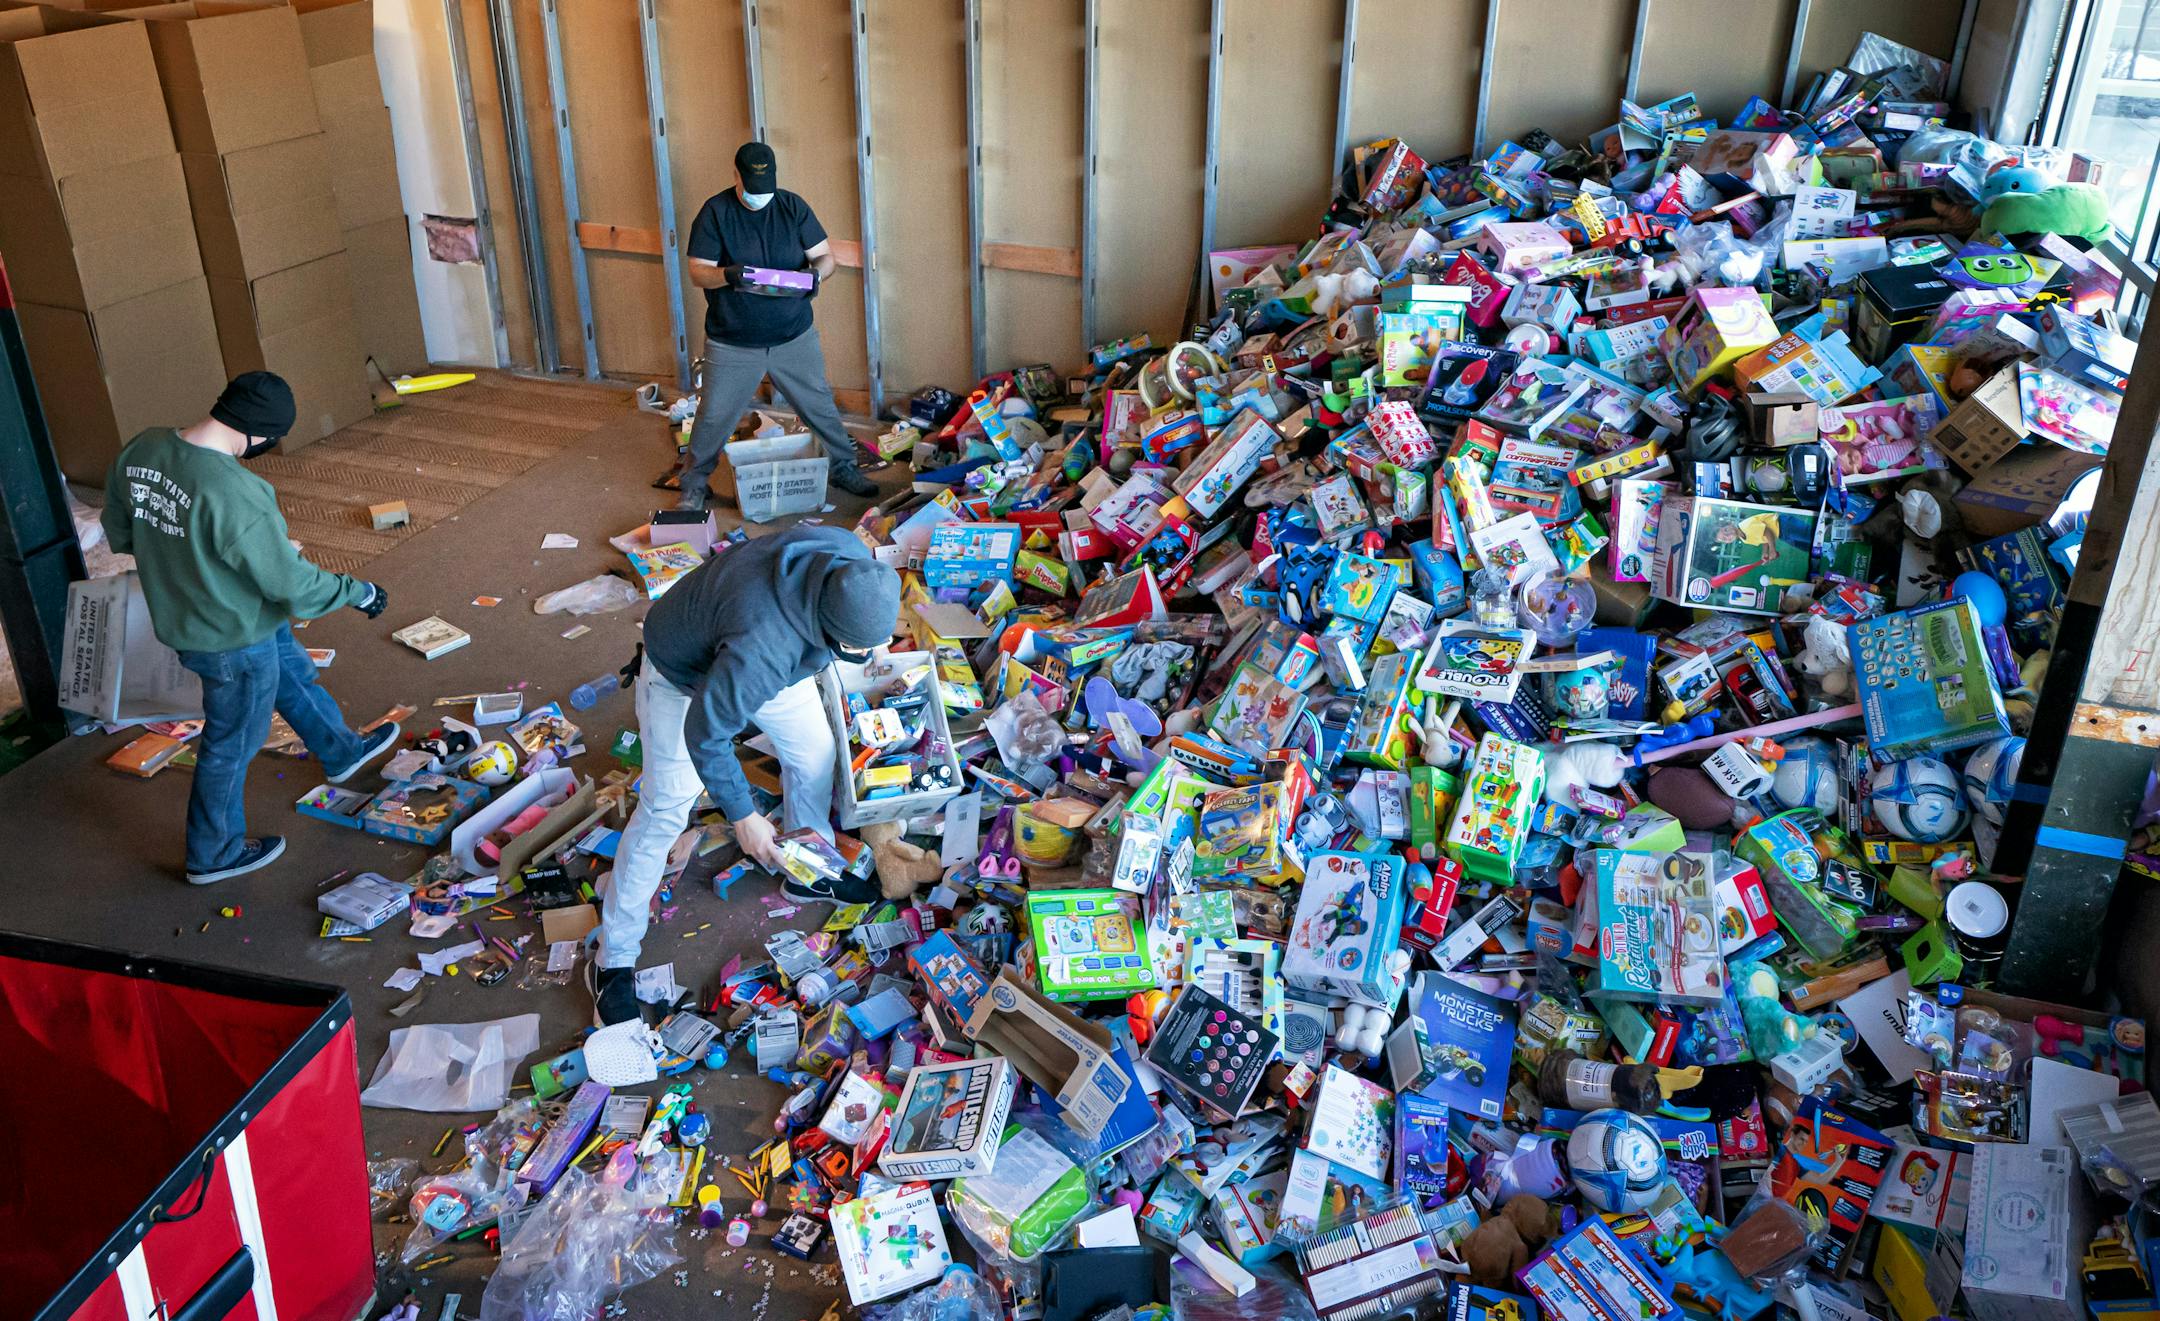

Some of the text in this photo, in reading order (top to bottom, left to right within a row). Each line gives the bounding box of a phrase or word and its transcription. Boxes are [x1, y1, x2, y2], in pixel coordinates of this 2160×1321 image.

[1450, 341, 1496, 358] Discovery
[126, 465, 162, 483] UNITED
[783, 480, 816, 489] STATES
[782, 487, 816, 497] SERVICE
[160, 521, 186, 538] CORPS
[1035, 566, 1062, 592] Hippos
[72, 595, 89, 700] POSTAL SERVICE
[82, 600, 98, 695] UNITED STATES
[1439, 669, 1510, 687] TROUBLE
[1610, 682, 1638, 708] ENSITY
[1866, 699, 1880, 743] STRUCTURAL
[1871, 691, 1886, 737] ENGINEERING
[1711, 754, 1740, 785] ASK ME
[527, 868, 561, 880] JUMP ROPE
[1371, 863, 1381, 895] Blast
[1381, 860, 1392, 900] Alpine
[1848, 870, 1866, 900] UNO
[1612, 923, 1627, 956] DINER
[1618, 905, 1652, 989] Restaurant
[1098, 976, 1111, 984] 100
[1433, 990, 1504, 1025] MONSTER
[1439, 1002, 1494, 1032] TRUCKS
[1056, 1029, 1097, 1061] Car Carrier
[1582, 1070, 1592, 1092] Polar
[953, 1065, 992, 1152] BATTLESHIP
[983, 1079, 1010, 1158] BATTLESHIP
[1822, 1111, 1846, 1122] NERF
[1681, 1142, 1708, 1160] baby
[887, 1157, 961, 1178] BATTLESHIP
[1410, 1182, 1440, 1193] GALAXY
[1370, 1261, 1419, 1283] PENCIL SET
[1599, 1243, 1637, 1285] SNO-BRICK
[1634, 1280, 1667, 1311] MAKER
[1559, 1270, 1597, 1311] SNO-BRICK
[1814, 1300, 1852, 1321] FROZE
